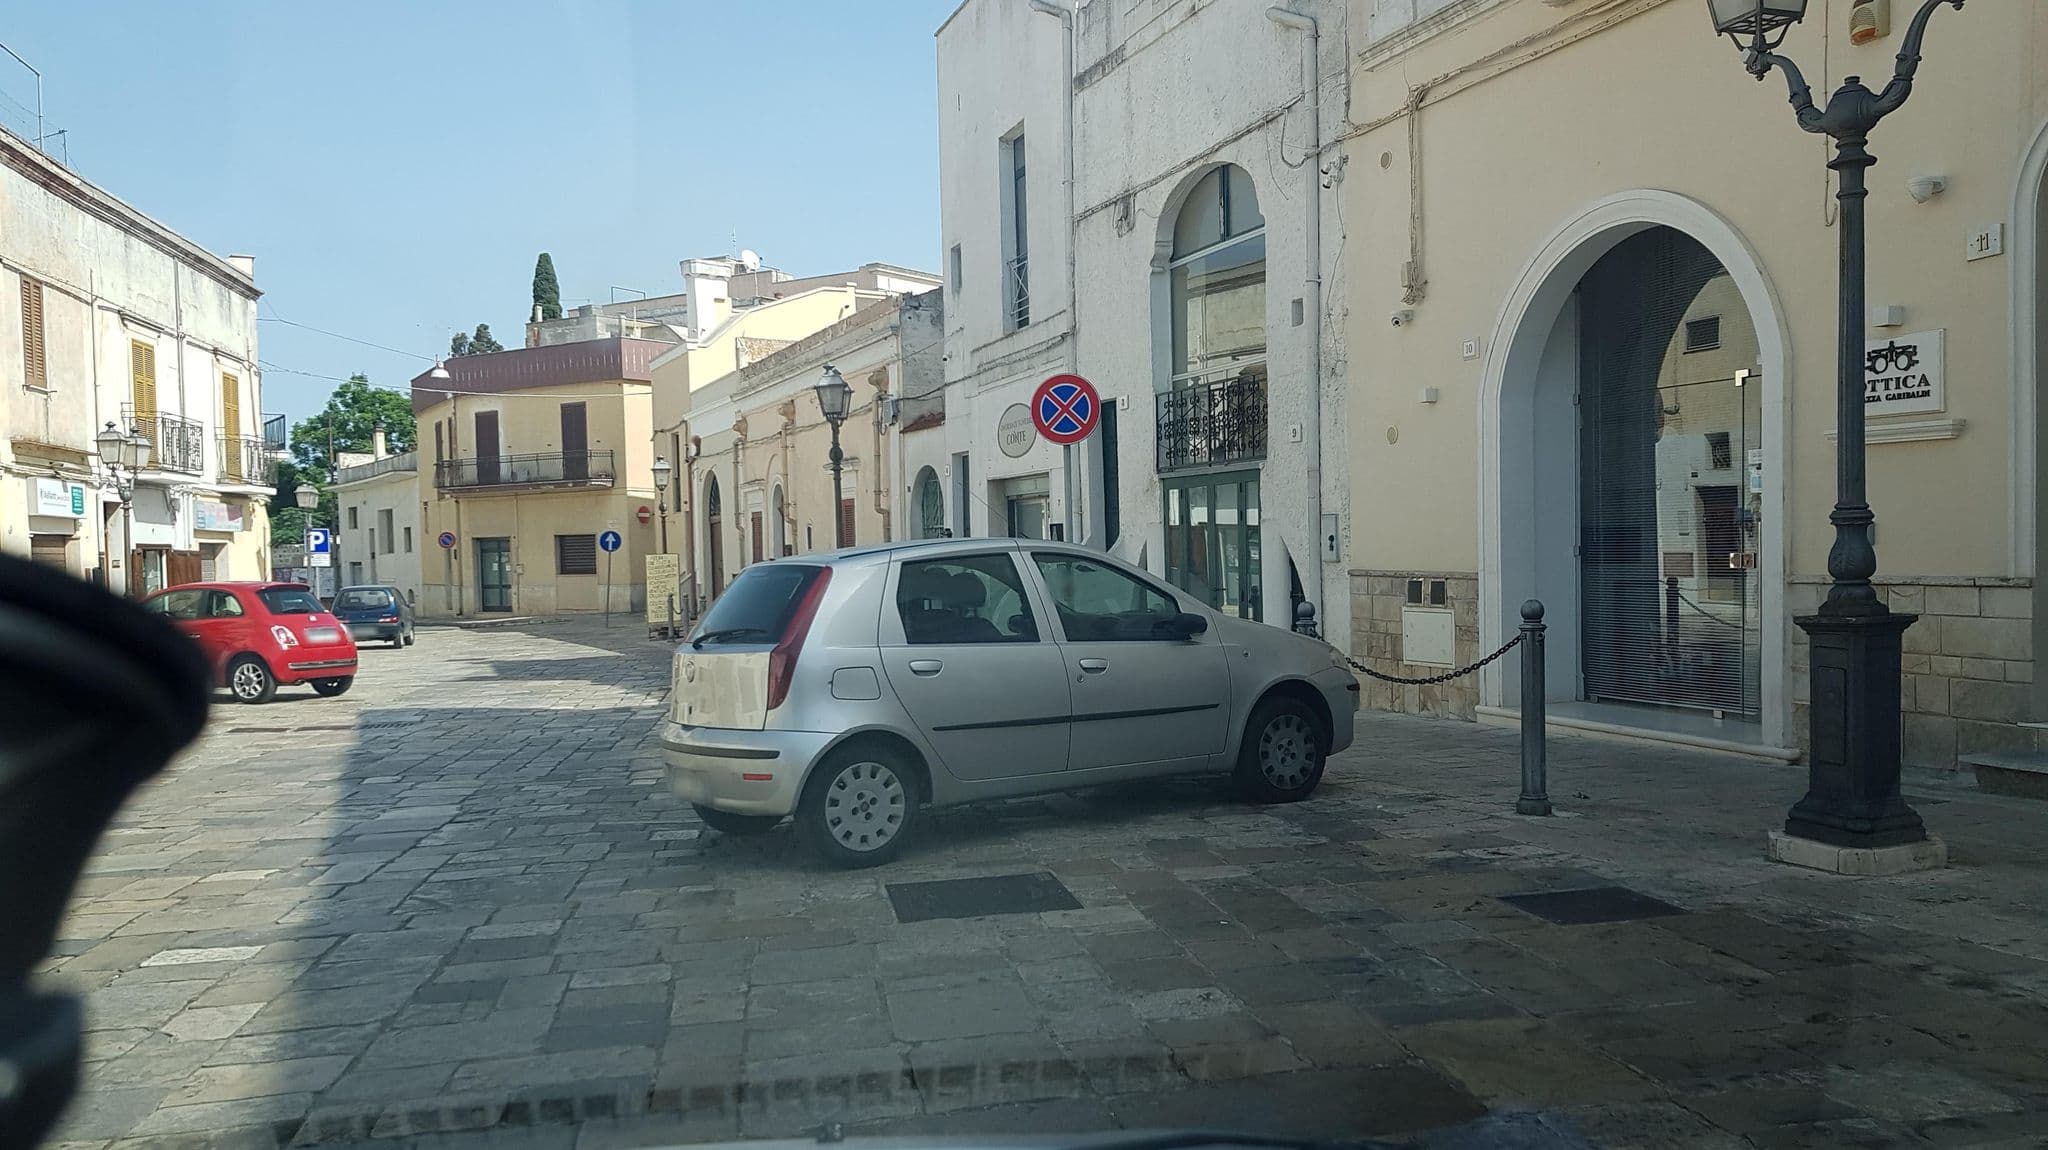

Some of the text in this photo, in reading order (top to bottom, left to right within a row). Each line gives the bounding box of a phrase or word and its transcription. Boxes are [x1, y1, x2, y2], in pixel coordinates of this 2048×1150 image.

[1976, 232, 1990, 251] 11
[1864, 373, 1931, 393] TTICA
[1864, 389, 1931, 403] ZZA GARIBALDI
[309, 531, 325, 551] P
